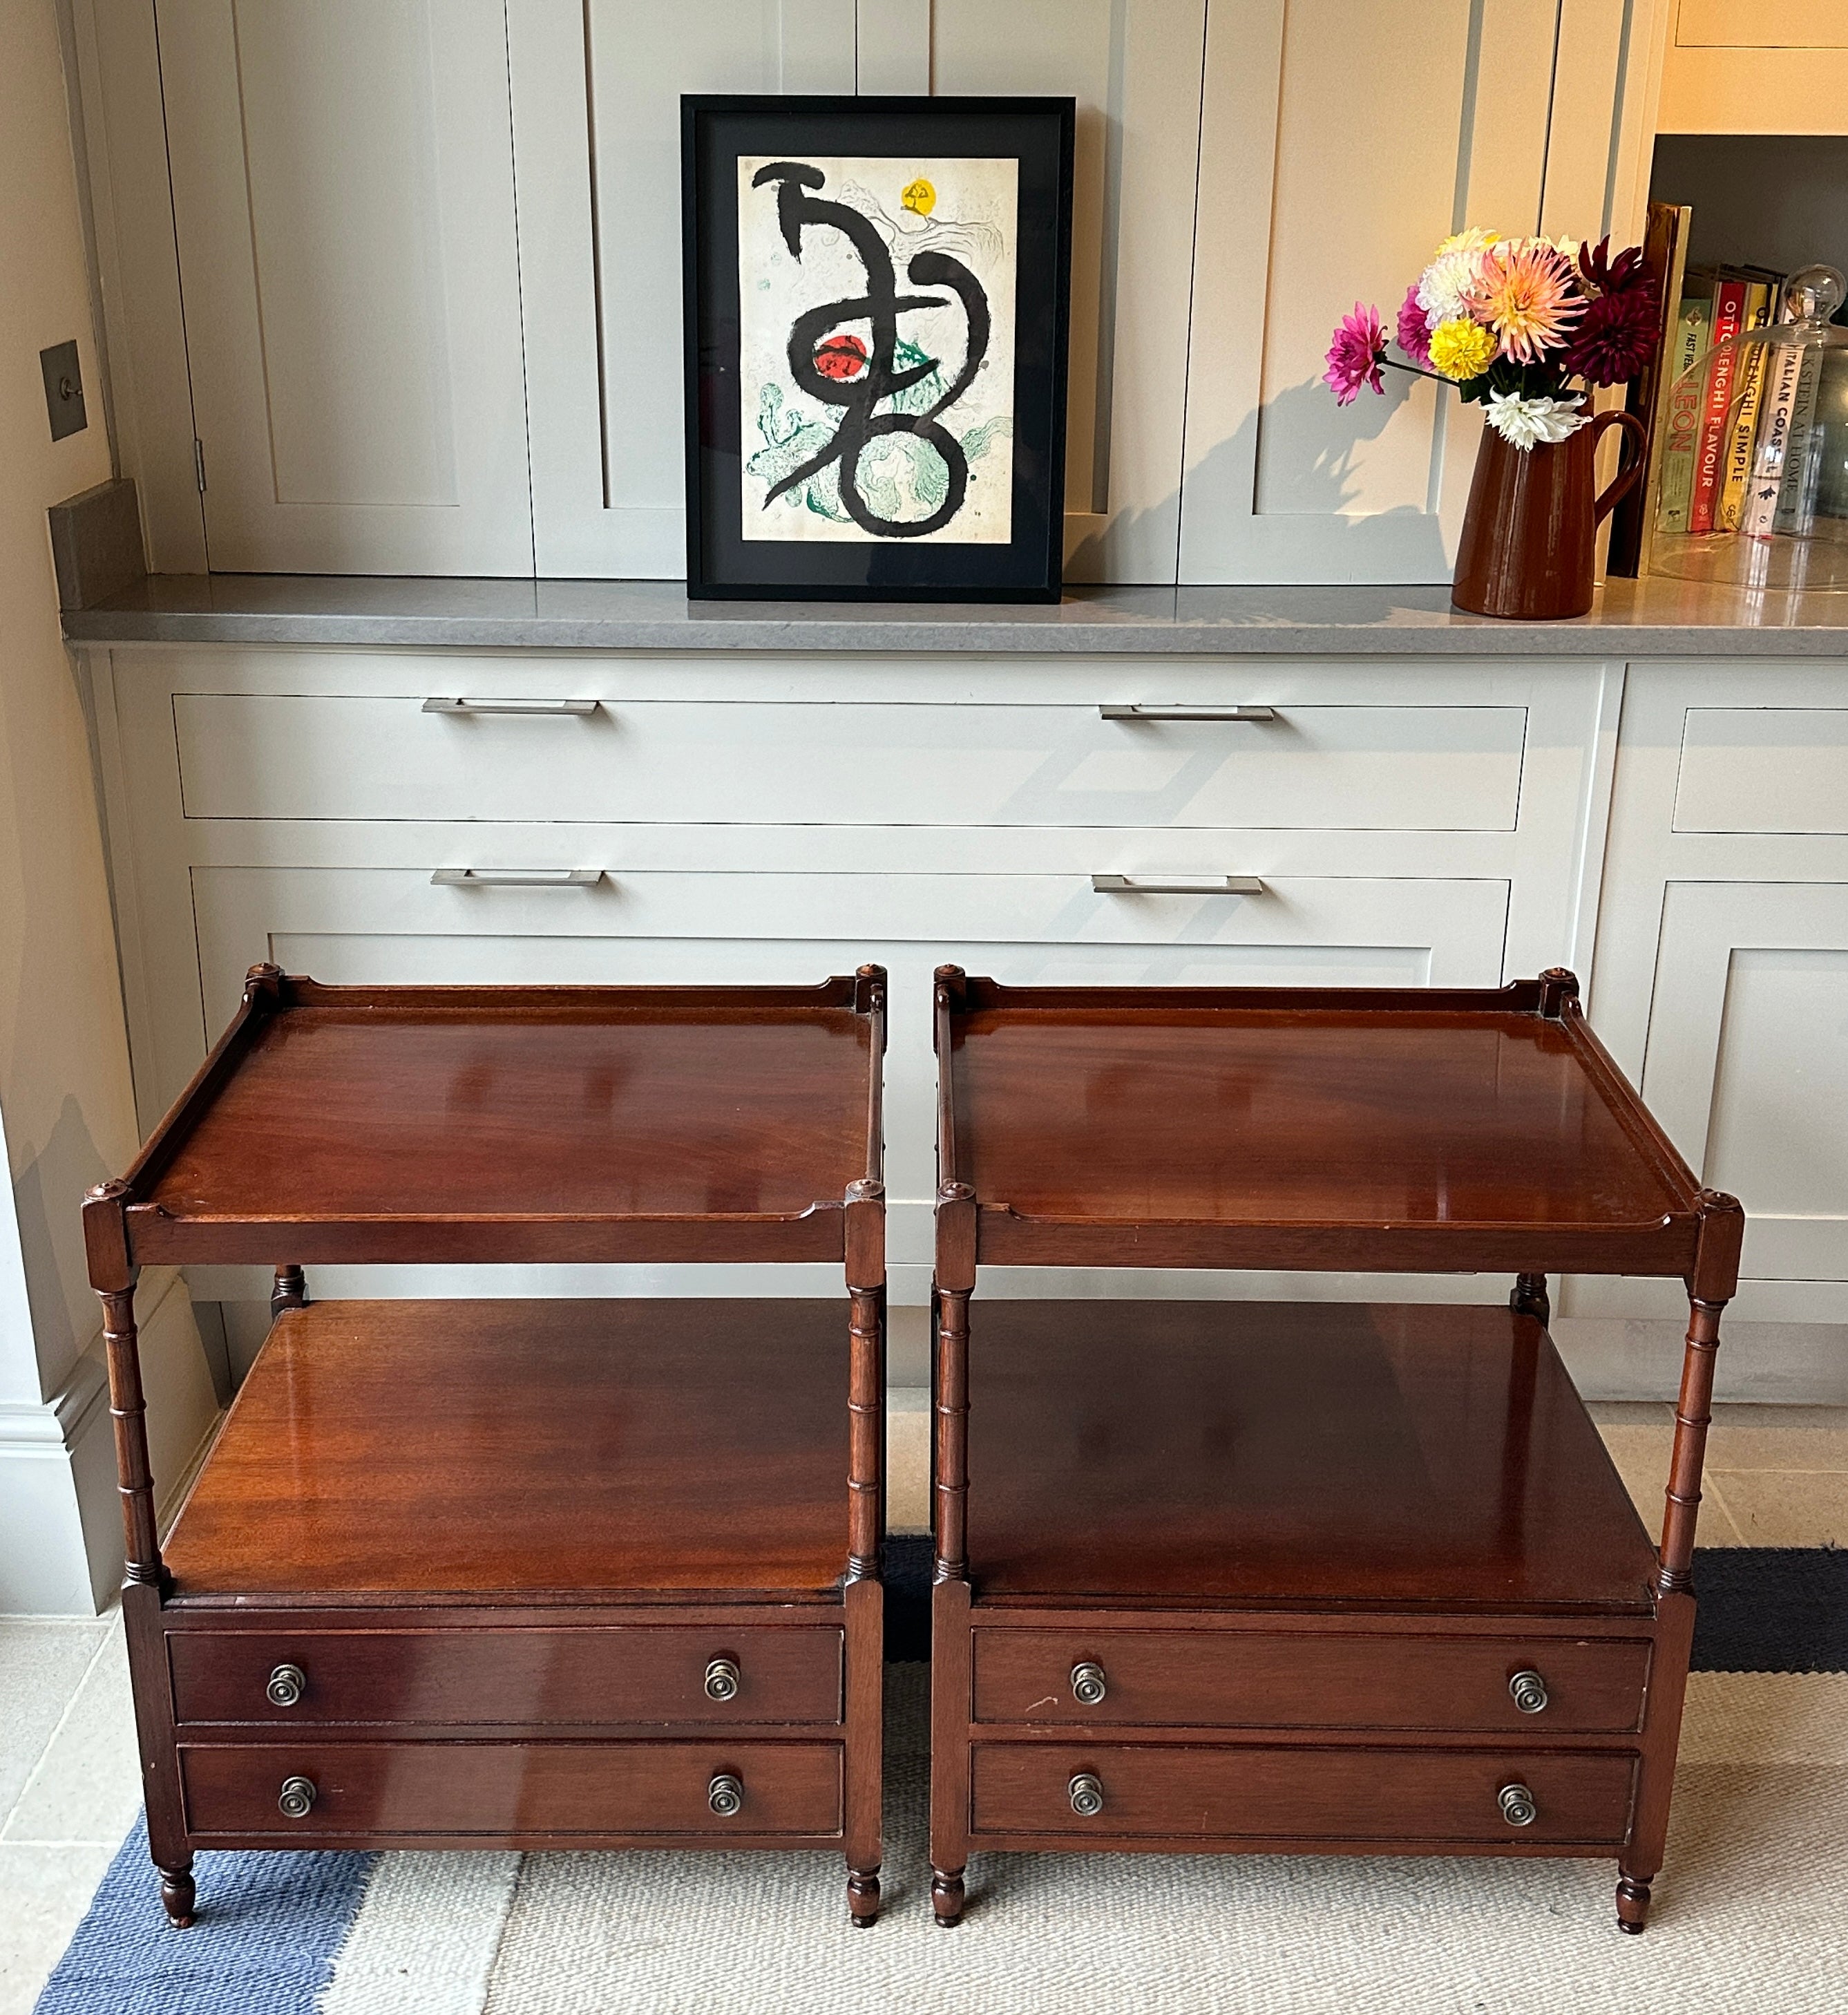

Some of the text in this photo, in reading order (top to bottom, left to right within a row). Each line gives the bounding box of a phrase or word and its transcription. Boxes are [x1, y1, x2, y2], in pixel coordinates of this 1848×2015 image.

[1685, 332, 1697, 353] FAST
[1713, 301, 1737, 409] OTTOLENGHI
[1741, 306, 1768, 416] OTOLENGHI
[1668, 381, 1699, 452] LEON
[1766, 350, 1798, 473] ITALIAN COASL
[1796, 370, 1813, 416] STEIN
[1702, 416, 1722, 488] FLAVOUR
[1732, 425, 1750, 482] SIMPLE
[1792, 422, 1805, 438] AT
[1787, 445, 1802, 493] HOME
